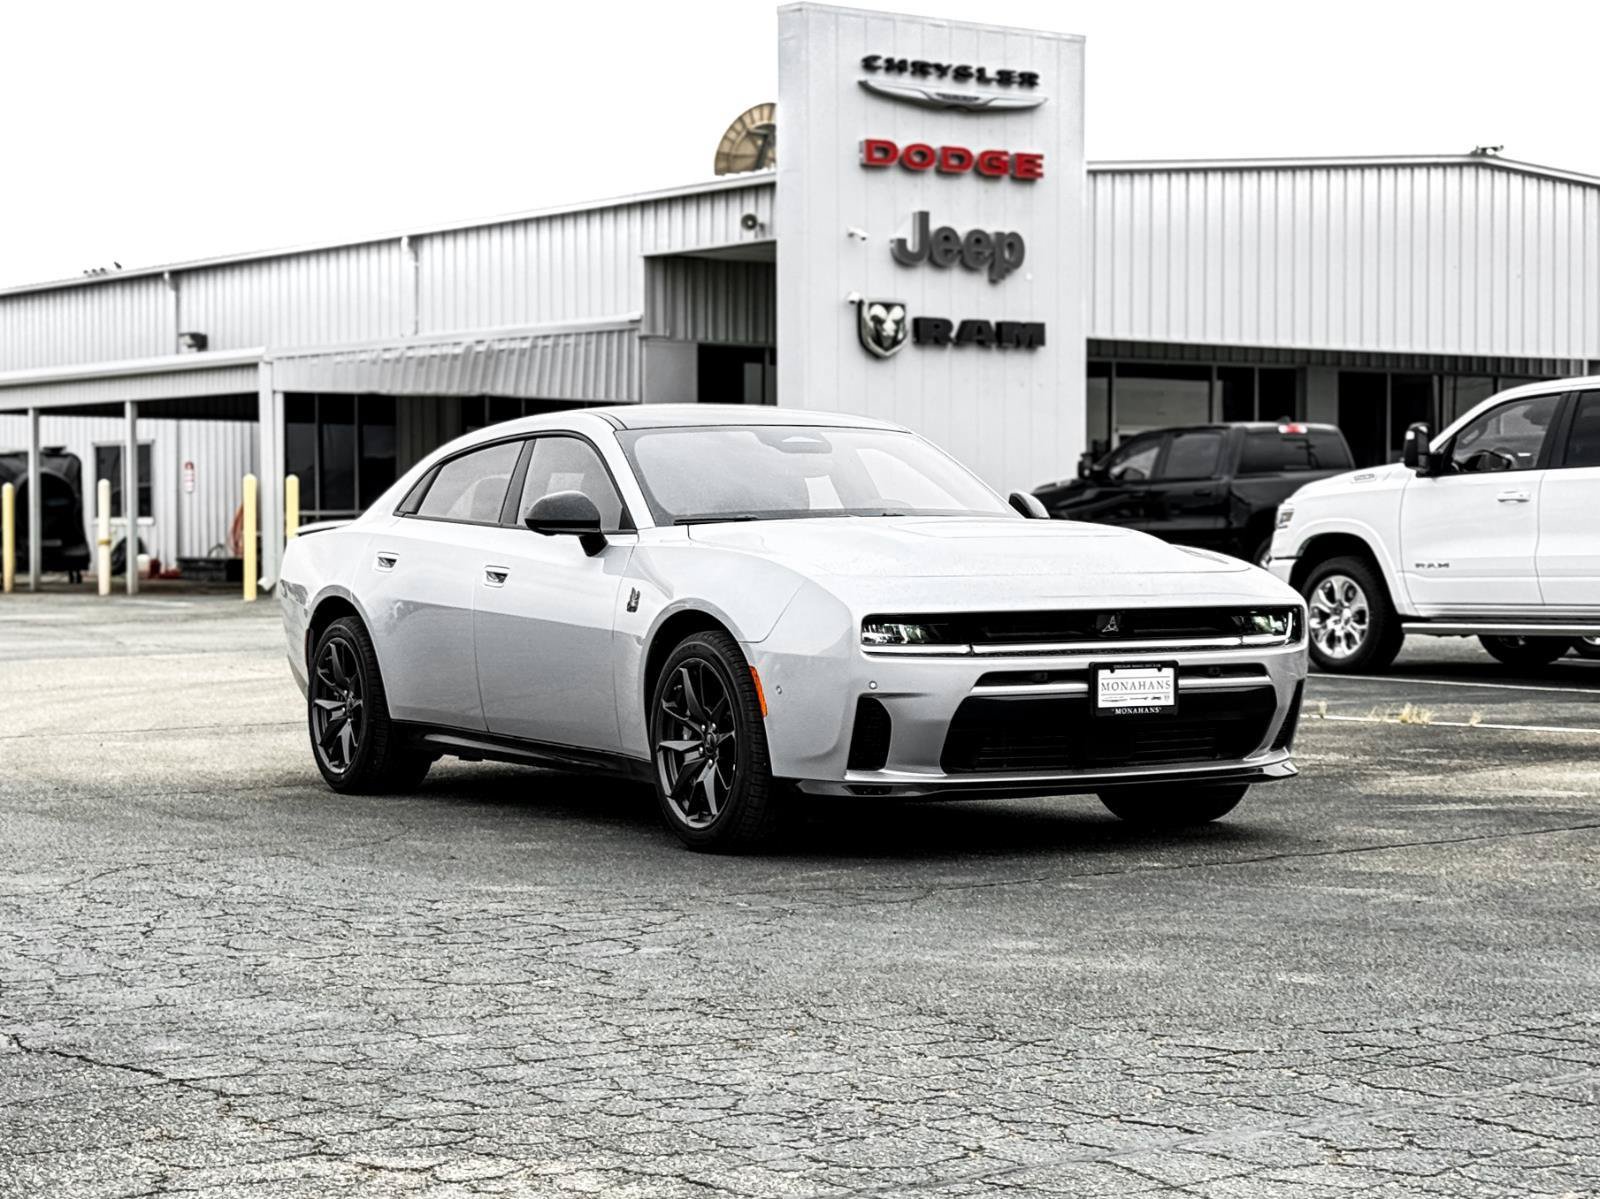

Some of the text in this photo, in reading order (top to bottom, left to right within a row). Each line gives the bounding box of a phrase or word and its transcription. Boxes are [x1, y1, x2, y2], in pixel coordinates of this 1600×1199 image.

[861, 54, 1040, 88] CHRYSLER
[859, 138, 1044, 181] DODGE
[890, 210, 1026, 284] Jeep
[912, 316, 1046, 350] RAM
[1101, 681, 1171, 692] MONAHANS
[1114, 706, 1161, 715] MONAHANS
